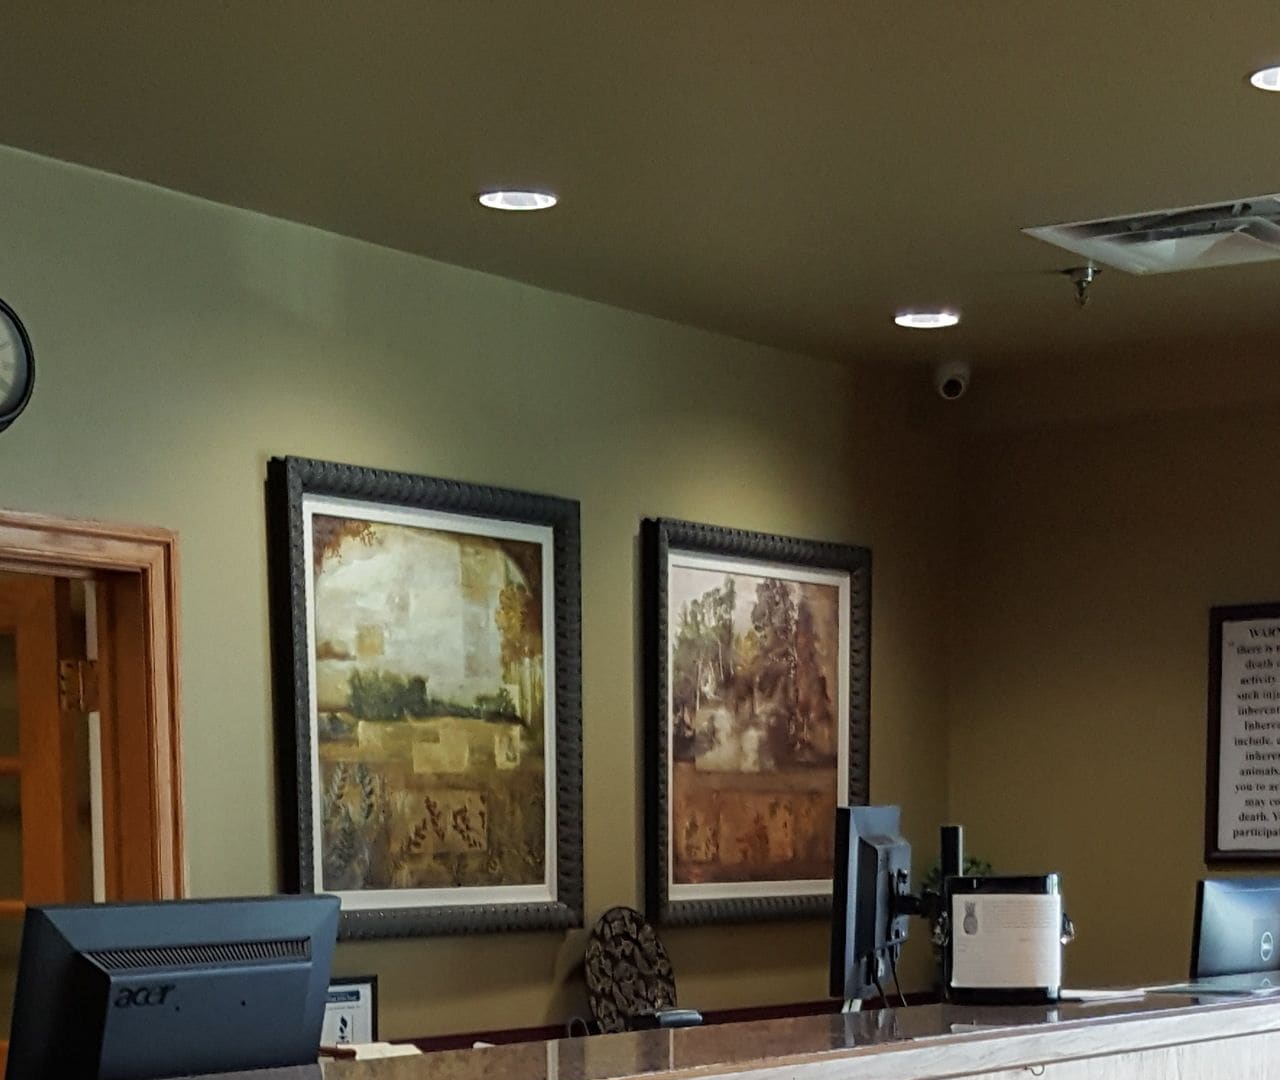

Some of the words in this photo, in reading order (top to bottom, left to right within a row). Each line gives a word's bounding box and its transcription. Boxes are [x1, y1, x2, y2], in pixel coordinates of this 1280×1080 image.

[1245, 658, 1273, 669] death
[1240, 673, 1276, 686] activity
[1237, 690, 1259, 700] such
[1237, 704, 1280, 716] inherent
[1235, 783, 1253, 794] you
[1256, 782, 1266, 791] to
[1245, 798, 1266, 807] may
[1238, 811, 1269, 822] death.
[114, 984, 176, 1009] acer
